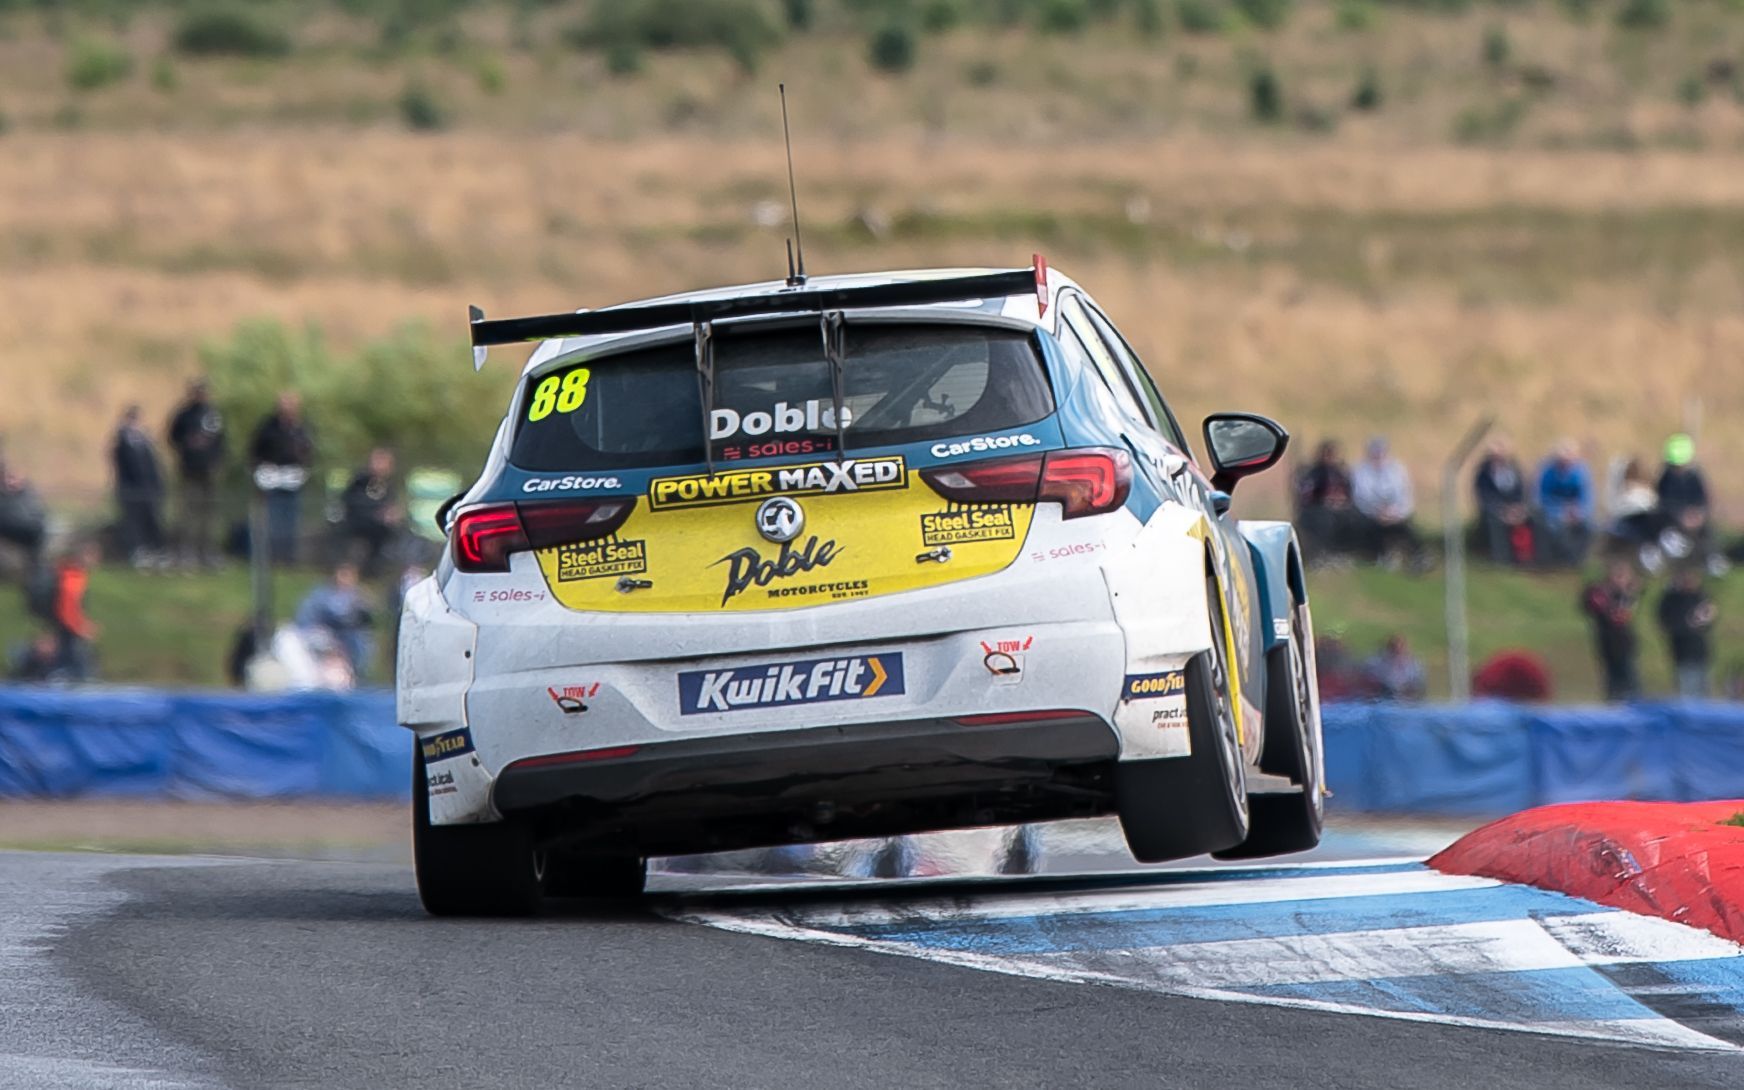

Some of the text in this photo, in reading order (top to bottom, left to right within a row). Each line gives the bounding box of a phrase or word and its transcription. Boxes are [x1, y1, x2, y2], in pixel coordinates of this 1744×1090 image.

[529, 368, 590, 422] 88
[710, 400, 852, 440] Doble
[748, 438, 832, 457] sales-i
[930, 433, 1041, 458] CarStore.
[522, 476, 622, 493] CarStore.
[657, 460, 898, 502] POWER MAXED
[923, 509, 1011, 532] Steel Seal
[927, 528, 1010, 541] HEAD GASKET FIX
[561, 542, 644, 568] Steel Seal
[561, 561, 642, 577] HEAD GASKET FIX
[705, 535, 846, 608] Doble
[767, 580, 869, 598] MOTORCYCLES
[997, 640, 1020, 653] TOW
[563, 686, 585, 698] TOW
